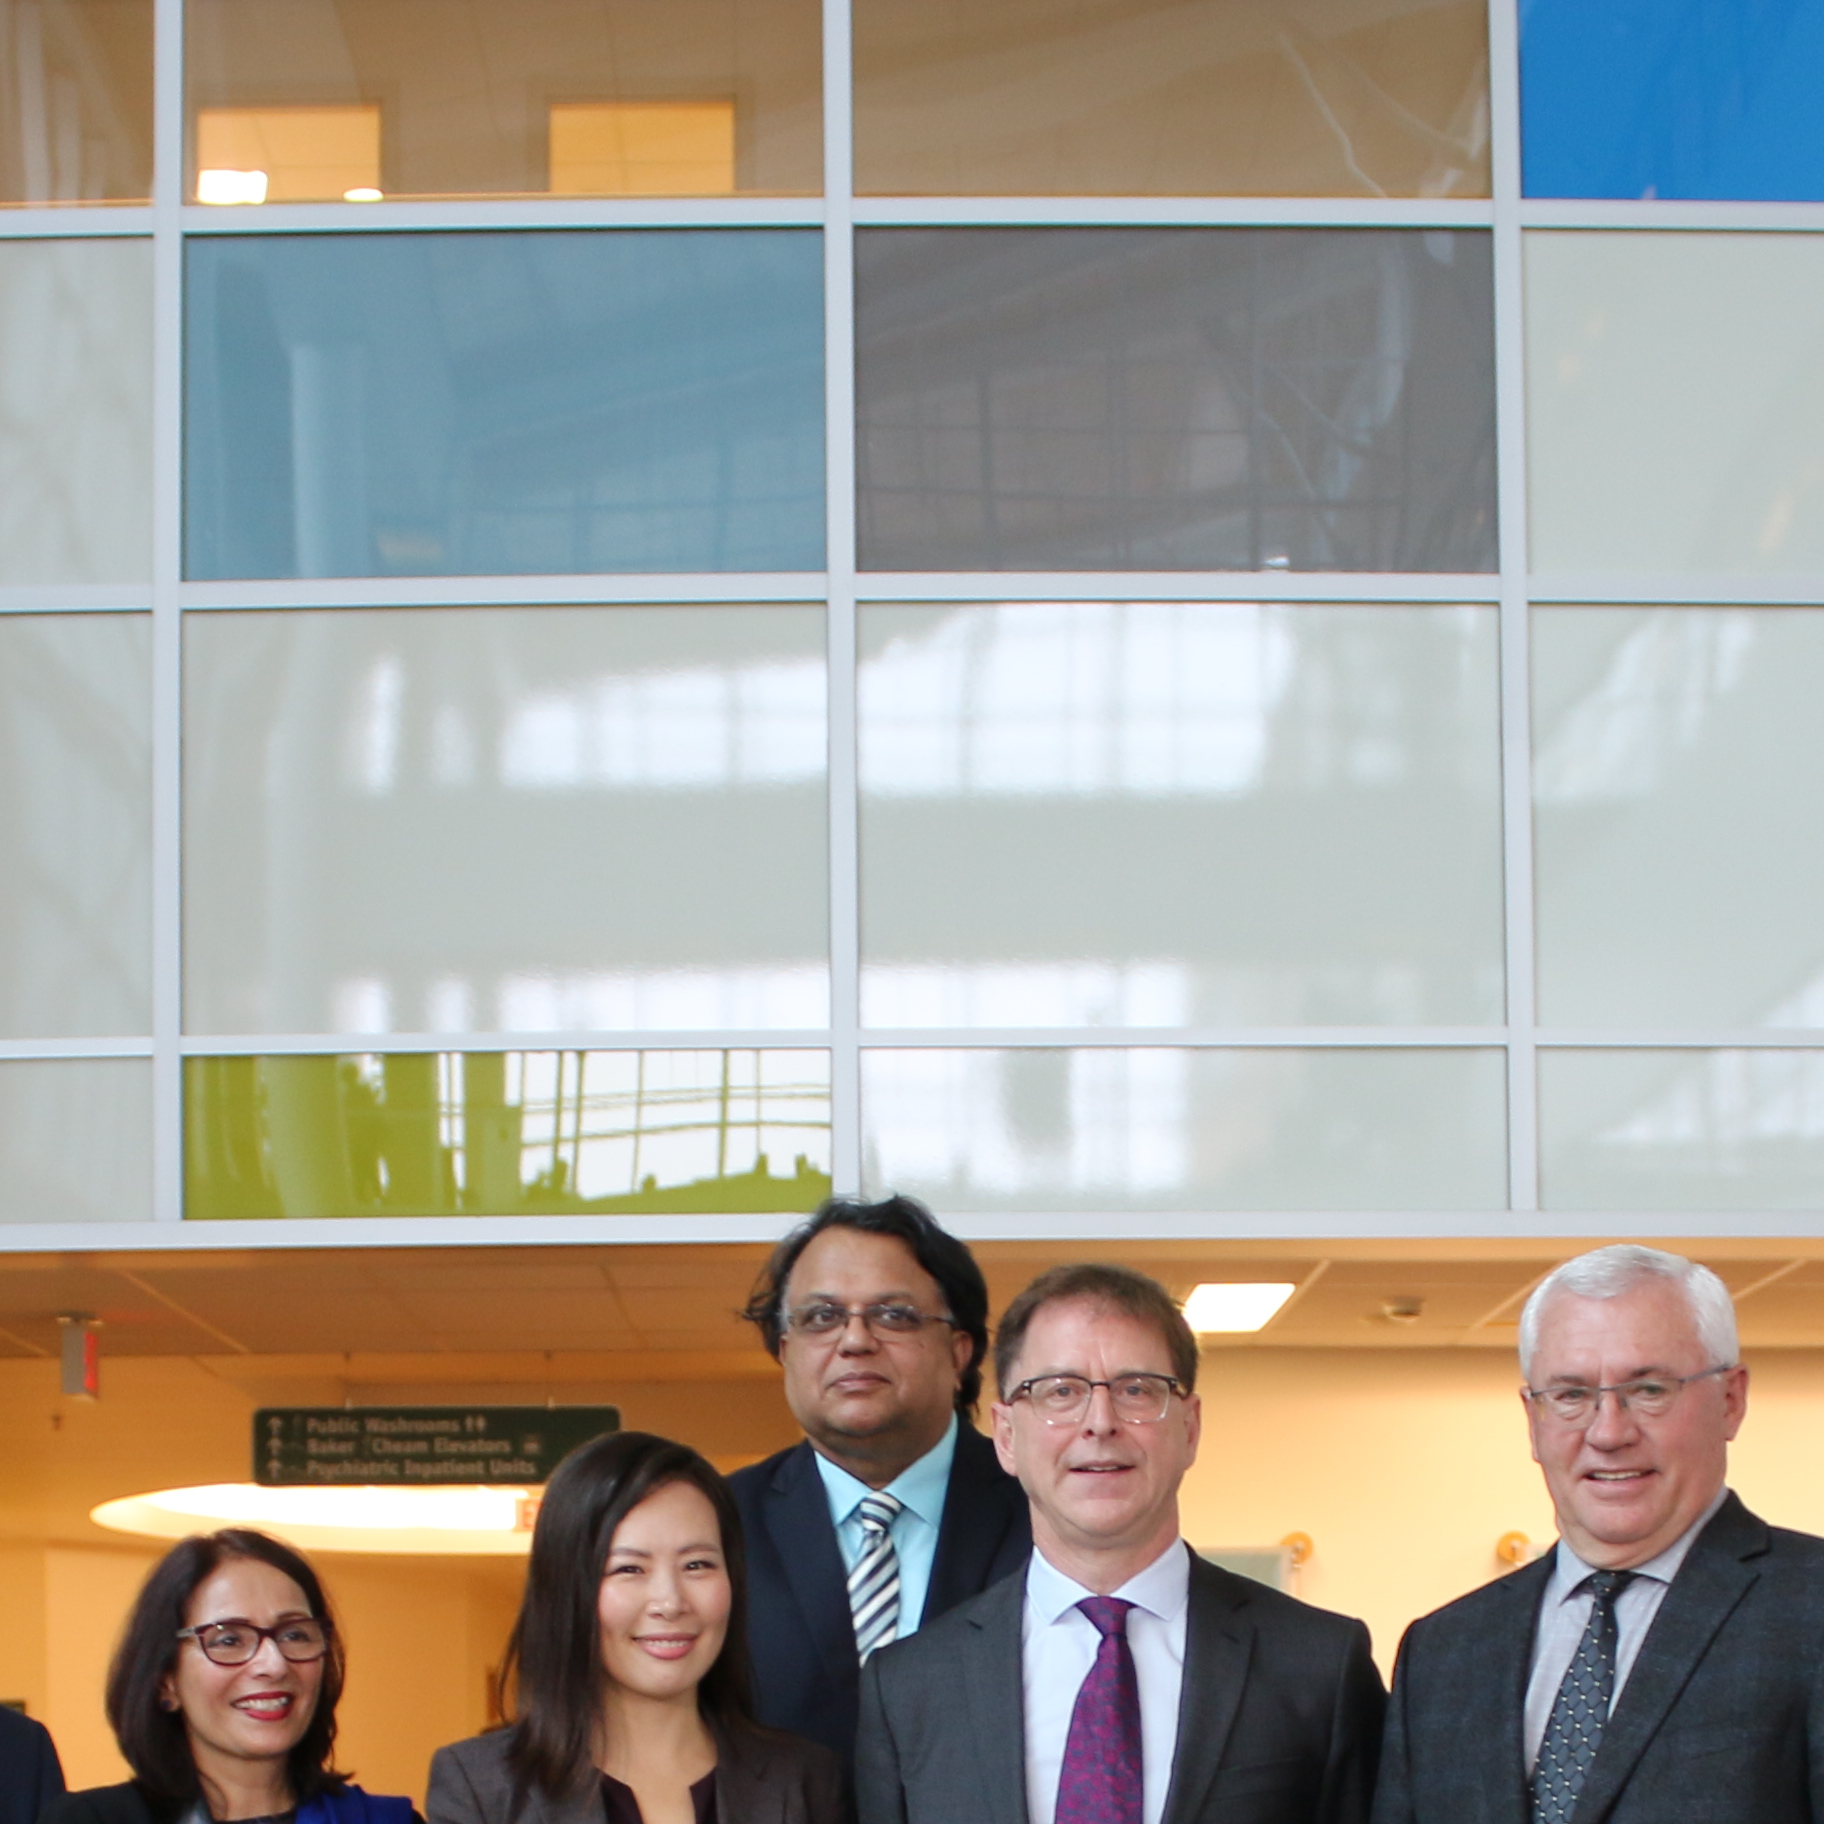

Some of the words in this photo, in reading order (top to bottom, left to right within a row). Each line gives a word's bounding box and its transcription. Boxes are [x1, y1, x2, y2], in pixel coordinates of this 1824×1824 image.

[306, 1416, 360, 1433] Public
[364, 1415, 461, 1433] Washrooms
[433, 1436, 511, 1454] Elevators
[306, 1459, 399, 1479] Psychiatric
[403, 1459, 485, 1478] Inpatient
[489, 1459, 537, 1475] Units
